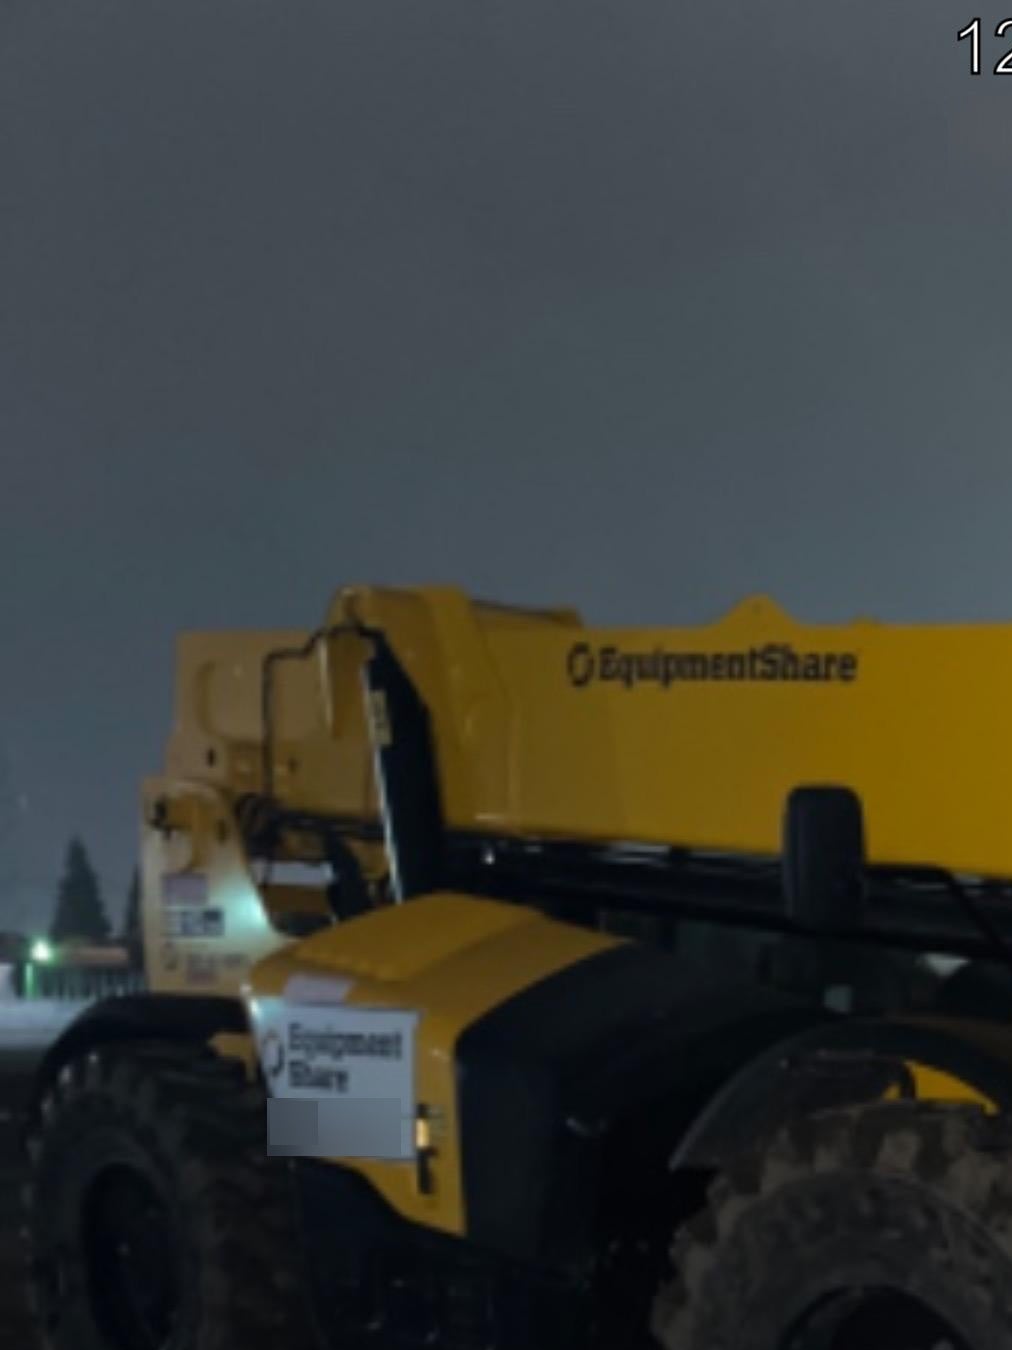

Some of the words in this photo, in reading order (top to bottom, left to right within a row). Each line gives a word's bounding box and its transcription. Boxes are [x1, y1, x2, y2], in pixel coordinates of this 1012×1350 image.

[598, 645, 858, 688] EquipmentShare
[288, 1022, 402, 1061] Equipment
[288, 1060, 349, 1093] Share
